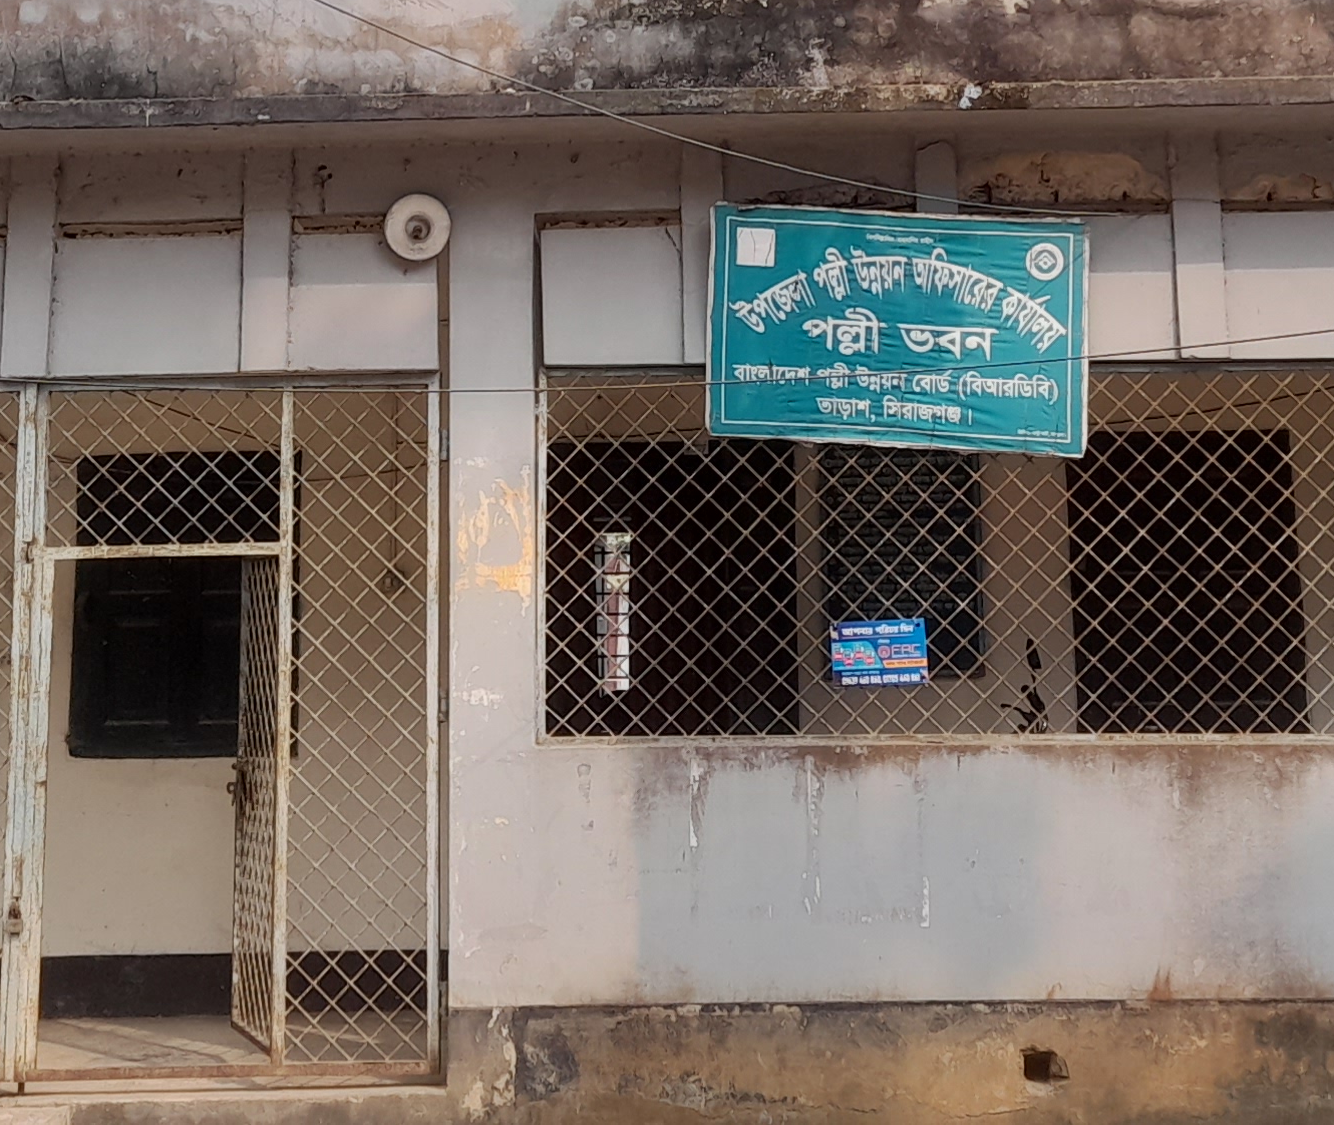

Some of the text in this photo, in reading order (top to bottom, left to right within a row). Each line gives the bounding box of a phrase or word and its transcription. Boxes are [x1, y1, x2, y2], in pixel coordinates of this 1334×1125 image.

[729, 245, 1067, 354] উপজেলা পল্লী উন্নয়ন অফিসারের কার্যালয়
[802, 307, 999, 361] পল্লী ভবন
[732, 362, 1059, 405] বাংলাদেশ পল্লী উন্নয়ন বোর্ড (বিআরডিবি)
[815, 396, 876, 423] তাড়াশ,
